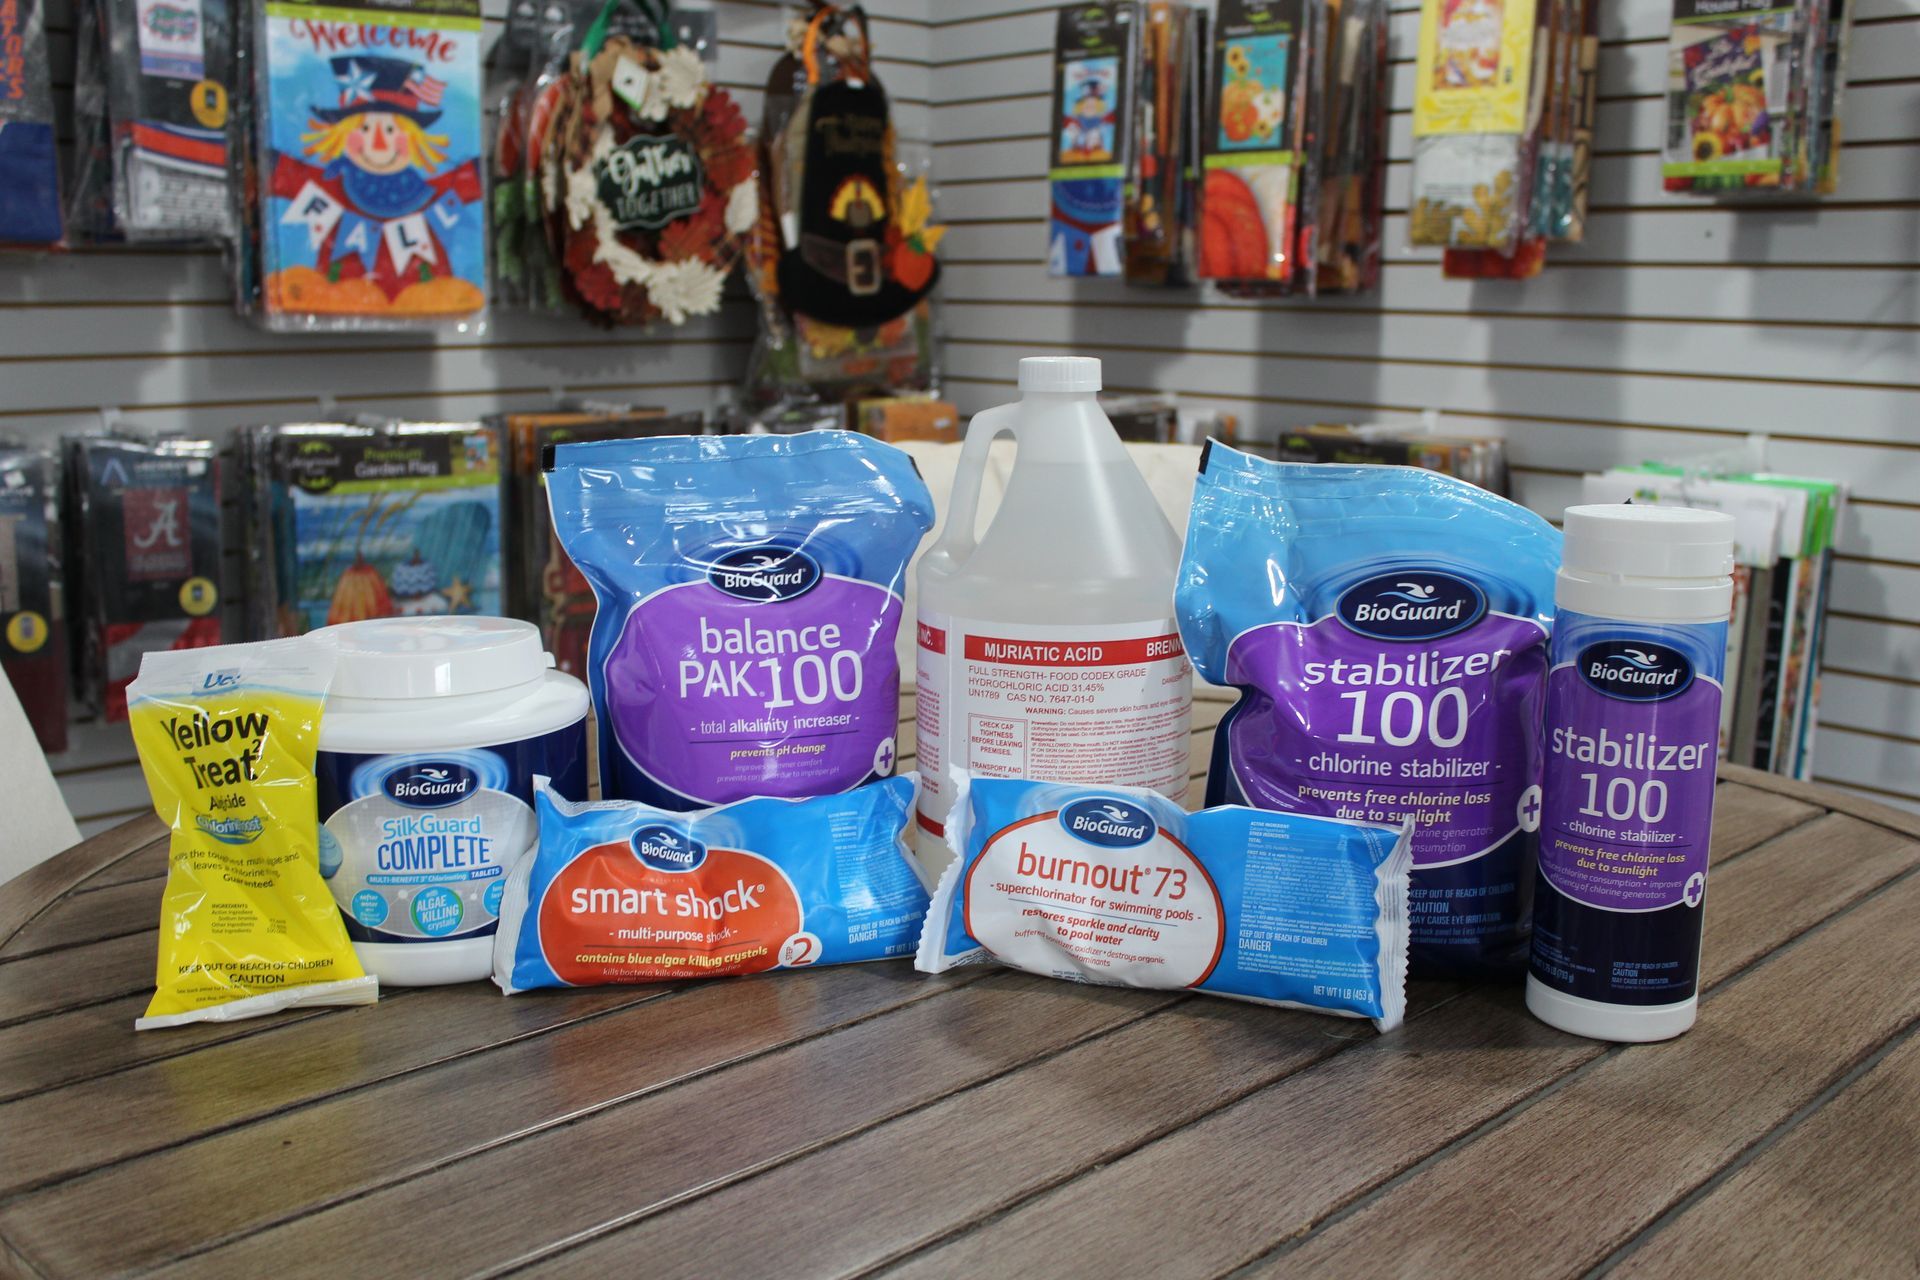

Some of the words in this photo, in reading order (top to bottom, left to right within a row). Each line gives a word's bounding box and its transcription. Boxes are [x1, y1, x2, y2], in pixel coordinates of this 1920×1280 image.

[290, 16, 456, 61] Welcome
[724, 568, 802, 589] BioGuard
[1355, 599, 1461, 622] BioGuard
[699, 616, 841, 655] balance
[984, 642, 1060, 661] MURIATIC
[1063, 646, 1103, 661] ACID
[679, 659, 757, 698] PAK
[758, 649, 863, 709] 100
[968, 665, 990, 676] FULL
[1049, 671, 1078, 681] FOOD
[1081, 670, 1114, 681] CODEX
[1117, 668, 1147, 679] GRADE
[1303, 650, 1512, 687] stabilizer
[1589, 662, 1678, 685] BioGuard
[968, 677, 1042, 692] HYDROCHLORIC
[1045, 683, 1069, 692] ACID
[1071, 683, 1105, 692] 31.45%
[968, 688, 1000, 699] UN1789
[1006, 692, 1026, 702] CAS
[1028, 694, 1047, 703] NO.
[1049, 694, 1095, 704] 7647-01-0
[1025, 706, 1067, 716] WARNING:
[1068, 707, 1095, 715] Causes
[1096, 706, 1118, 715] severe
[1119, 703, 1133, 713] skin
[1337, 686, 1469, 748] 100
[160, 711, 269, 752] Yellow
[700, 719, 727, 734] total
[728, 717, 789, 734] alkalinity
[793, 712, 852, 729] increaser
[979, 720, 1000, 729] CHECK
[1000, 722, 1014, 730] CAP
[971, 736, 995, 745] BEFORE
[995, 739, 1023, 748] LEAVING
[980, 729, 1014, 739] TIGHTNESS
[730, 748, 775, 760] prevents
[776, 745, 791, 757] pH
[791, 743, 827, 755] change
[1552, 726, 1709, 771] stabilizer
[1308, 751, 1393, 777] chlorine
[1399, 757, 1491, 779] stabilizer
[395, 780, 467, 797] BioGuard
[1297, 783, 1361, 802] prevents
[1364, 789, 1397, 807] free
[1399, 791, 1460, 806] chlorine
[1463, 791, 1491, 804] loss
[1578, 772, 1668, 824] 100
[1335, 805, 1365, 820] due
[1368, 807, 1384, 821] to
[382, 815, 481, 840] SilkGuard
[1072, 815, 1144, 840] BioGuard
[1569, 820, 1617, 839] chlorine
[1620, 829, 1677, 843] stabilizer
[377, 835, 490, 872] COMPLETE
[641, 841, 694, 864] BioGuard
[1554, 839, 1595, 857] prevents
[1596, 848, 1619, 861] free
[1621, 852, 1665, 864] chlorine
[1666, 853, 1686, 863] loss
[369, 874, 419, 885] MULTI-BENEFIT
[471, 866, 500, 879] TABLETS
[1016, 841, 1144, 895] burnout
[1153, 866, 1188, 900] 73
[1576, 857, 1596, 870] due
[1598, 862, 1610, 872] to
[1611, 864, 1659, 878] sunlight
[1588, 873, 1641, 889] consumption
[570, 887, 669, 916] smart
[674, 879, 760, 920] shock
[995, 882, 1087, 904] superchlorinator
[1090, 896, 1106, 910] for
[1109, 900, 1163, 920] swimming
[1165, 909, 1194, 921] pools
[1589, 884, 1621, 897] chlorine
[1622, 887, 1667, 900] generators
[416, 894, 447, 912] ALGAE
[1409, 901, 1449, 913] CAUTION
[421, 904, 460, 924] KILLING
[1022, 907, 1066, 923] restores
[1067, 913, 1106, 931] sparkle
[1107, 921, 1127, 933] and
[1127, 924, 1160, 941] clarity
[617, 926, 704, 943] multi-purpose
[706, 928, 732, 944] shock
[849, 929, 878, 944] DANGER
[1056, 925, 1068, 936] to
[1069, 927, 1094, 943] pool
[1095, 933, 1124, 946] water
[1239, 937, 1272, 952] DANGER
[575, 953, 626, 965] contains
[627, 952, 653, 964] blue
[655, 952, 687, 967] algae
[688, 954, 723, 967] killing
[723, 946, 769, 965] crystals
[791, 939, 812, 966] 2
[1075, 944, 1104, 956] oxidizer
[1106, 949, 1138, 962] destroys
[203, 961, 224, 972] OUT
[225, 962, 238, 971] OF
[239, 961, 271, 971] REACH
[272, 962, 287, 971] OF
[287, 958, 334, 971] CHILDREN
[603, 967, 620, 977] kills
[229, 973, 285, 985] CAUTION
[1313, 985, 1325, 995] NET
[1326, 987, 1338, 996] WT
[1343, 988, 1352, 998] LB
